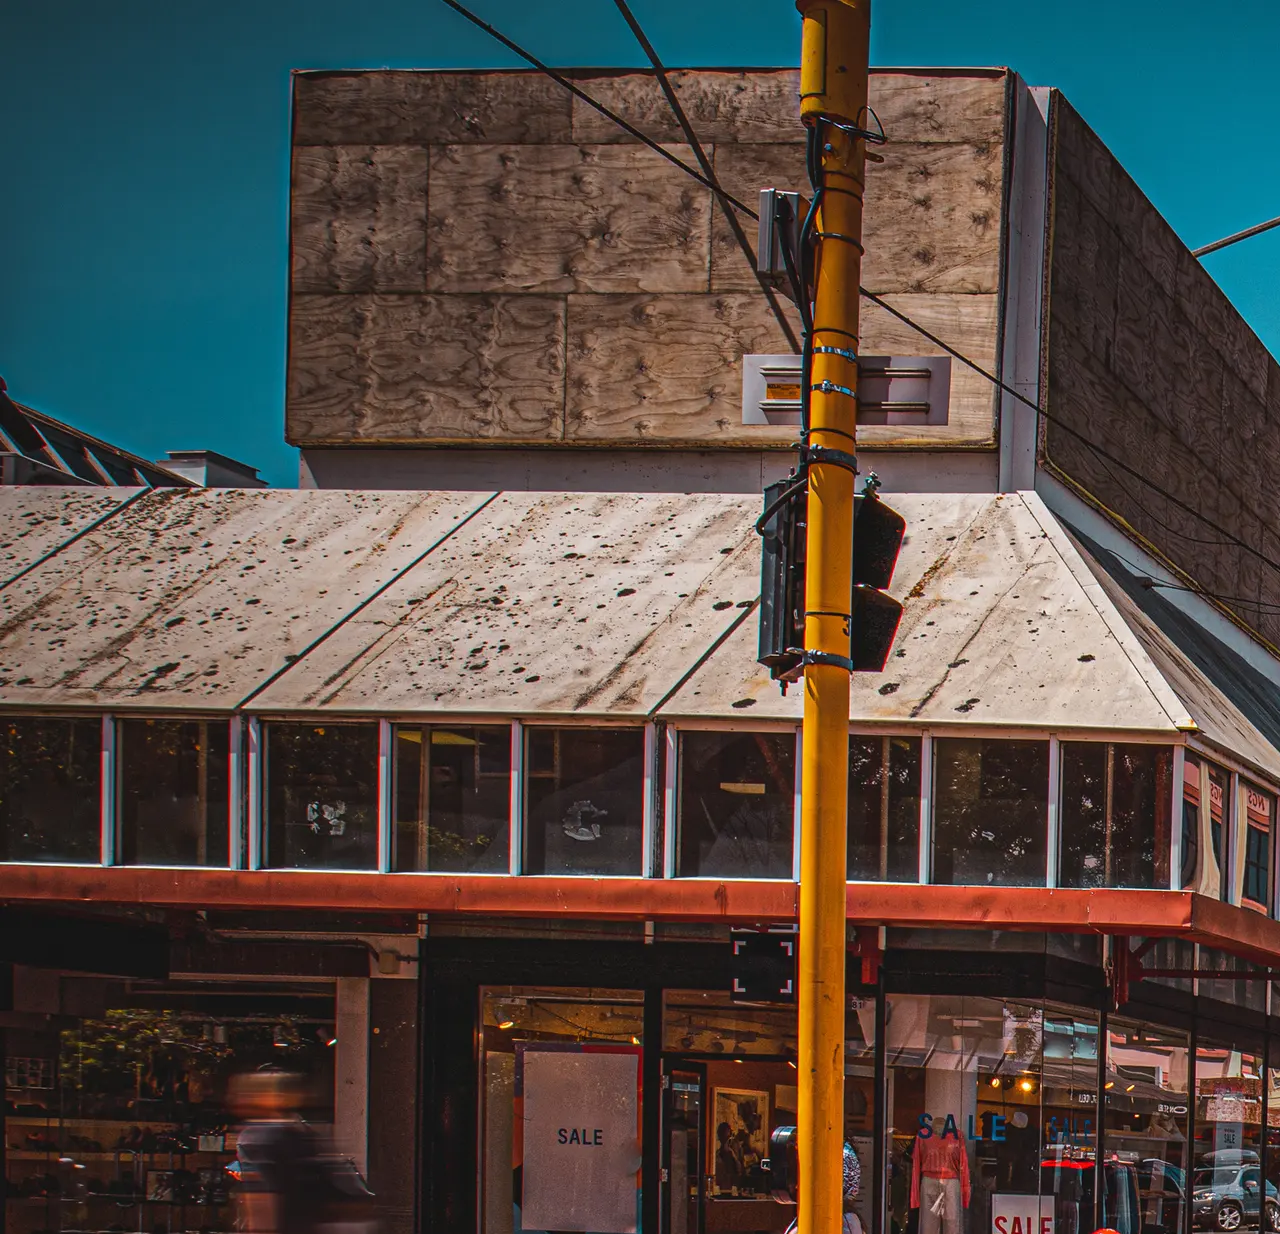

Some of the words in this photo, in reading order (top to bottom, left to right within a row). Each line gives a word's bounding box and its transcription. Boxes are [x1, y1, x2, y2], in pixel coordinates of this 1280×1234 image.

[557, 1128, 603, 1146] SALE
[917, 1113, 1007, 1142] SALE
[1049, 1116, 1092, 1145] SALE
